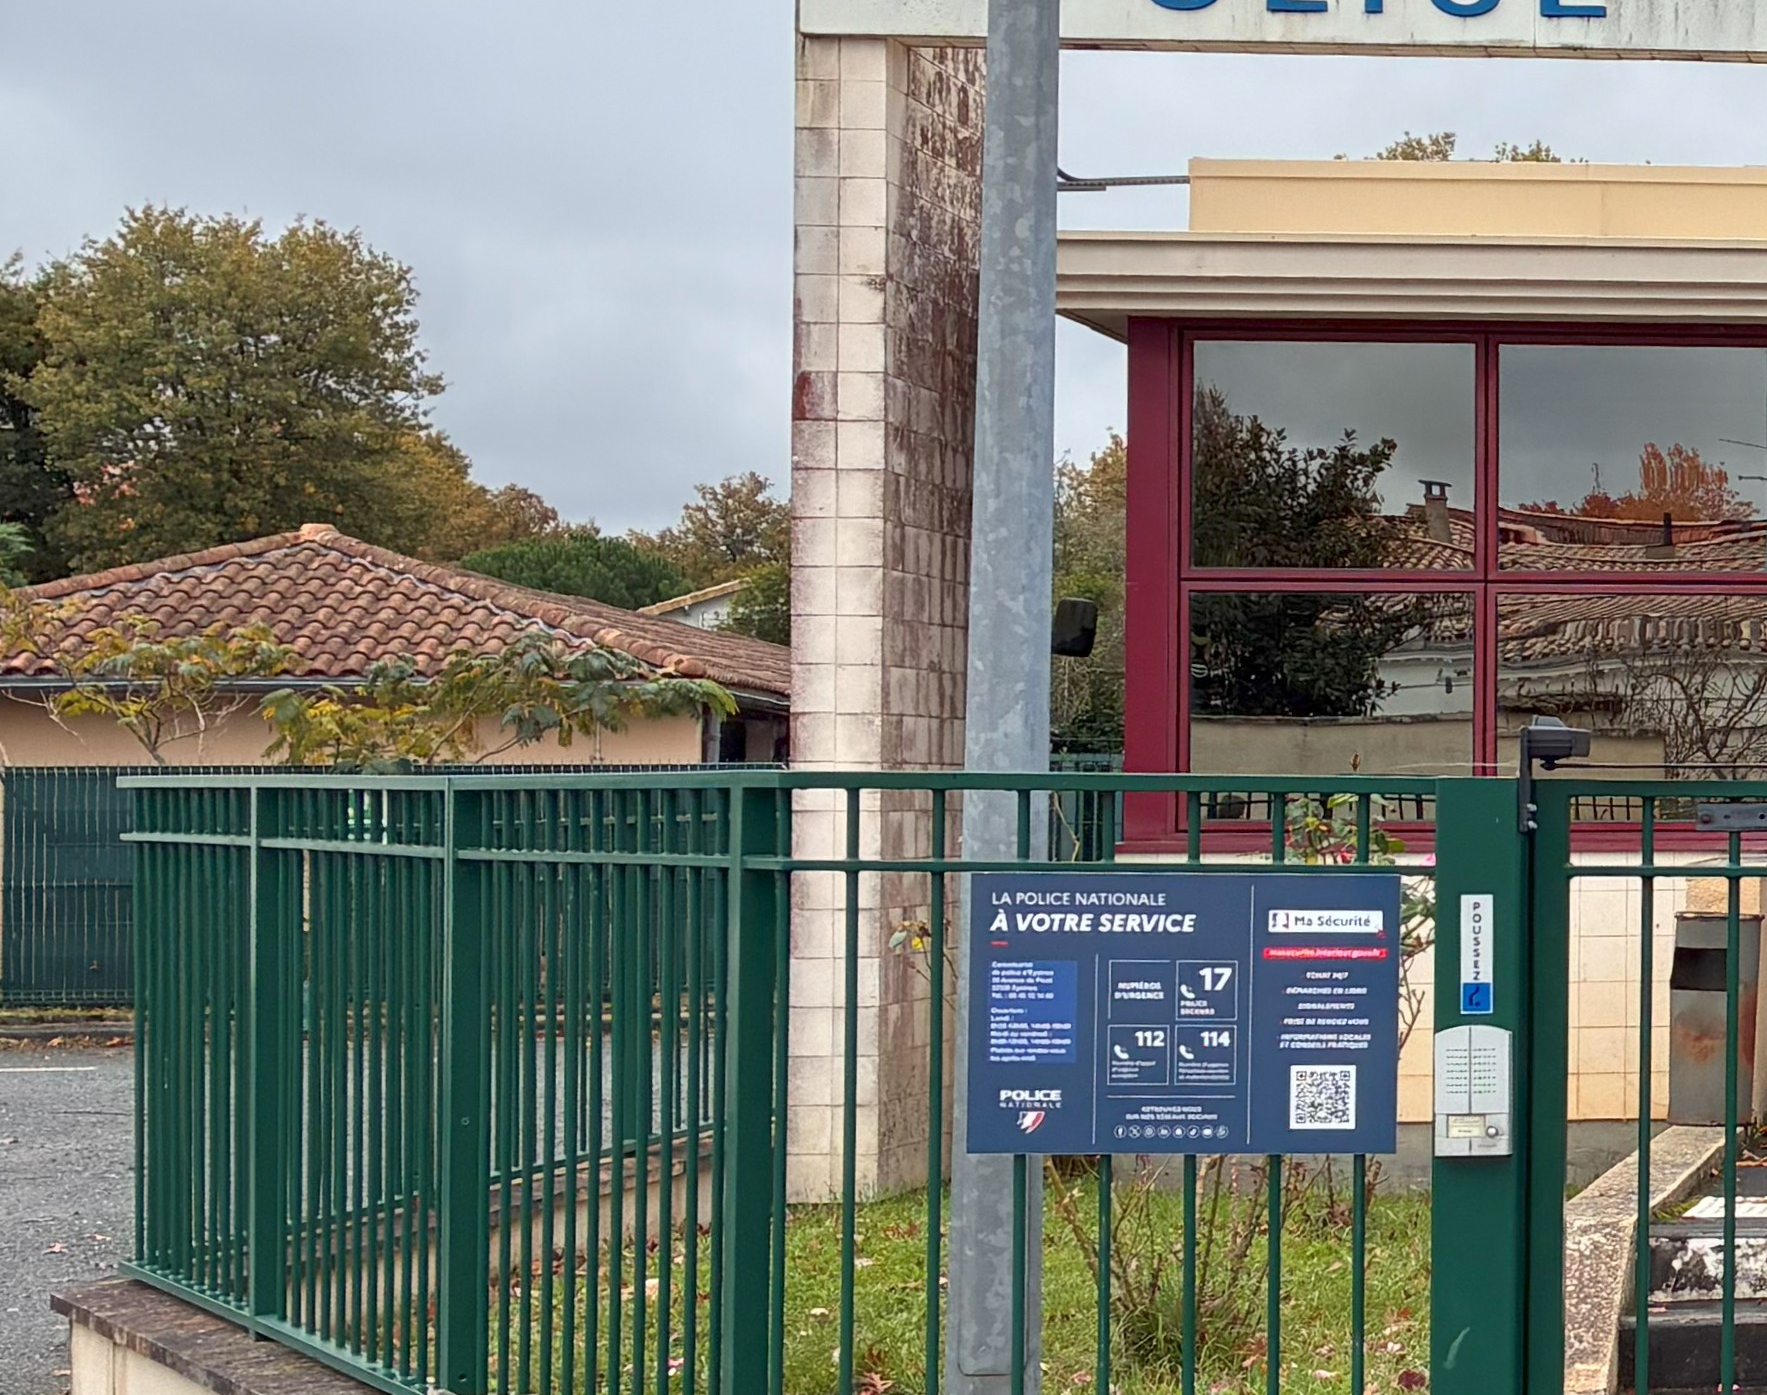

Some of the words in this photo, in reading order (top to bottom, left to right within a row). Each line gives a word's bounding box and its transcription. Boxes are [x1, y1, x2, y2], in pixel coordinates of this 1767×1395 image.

[992, 892, 1012, 905] LA
[1016, 892, 1071, 906] POLICE
[1075, 892, 1167, 906] NATIONALE
[990, 909, 1009, 932] À
[1016, 913, 1094, 932] VOTRE
[1098, 913, 1197, 933] SERVICE
[1294, 916, 1313, 927] Ma
[1317, 915, 1371, 927] Sécurité
[1472, 901, 1482, 981] POUSSEZ
[1199, 967, 1233, 991] 17
[1135, 1031, 1165, 1047] 112
[1200, 1031, 1231, 1047] 114
[1000, 1089, 1062, 1101] POLICE
